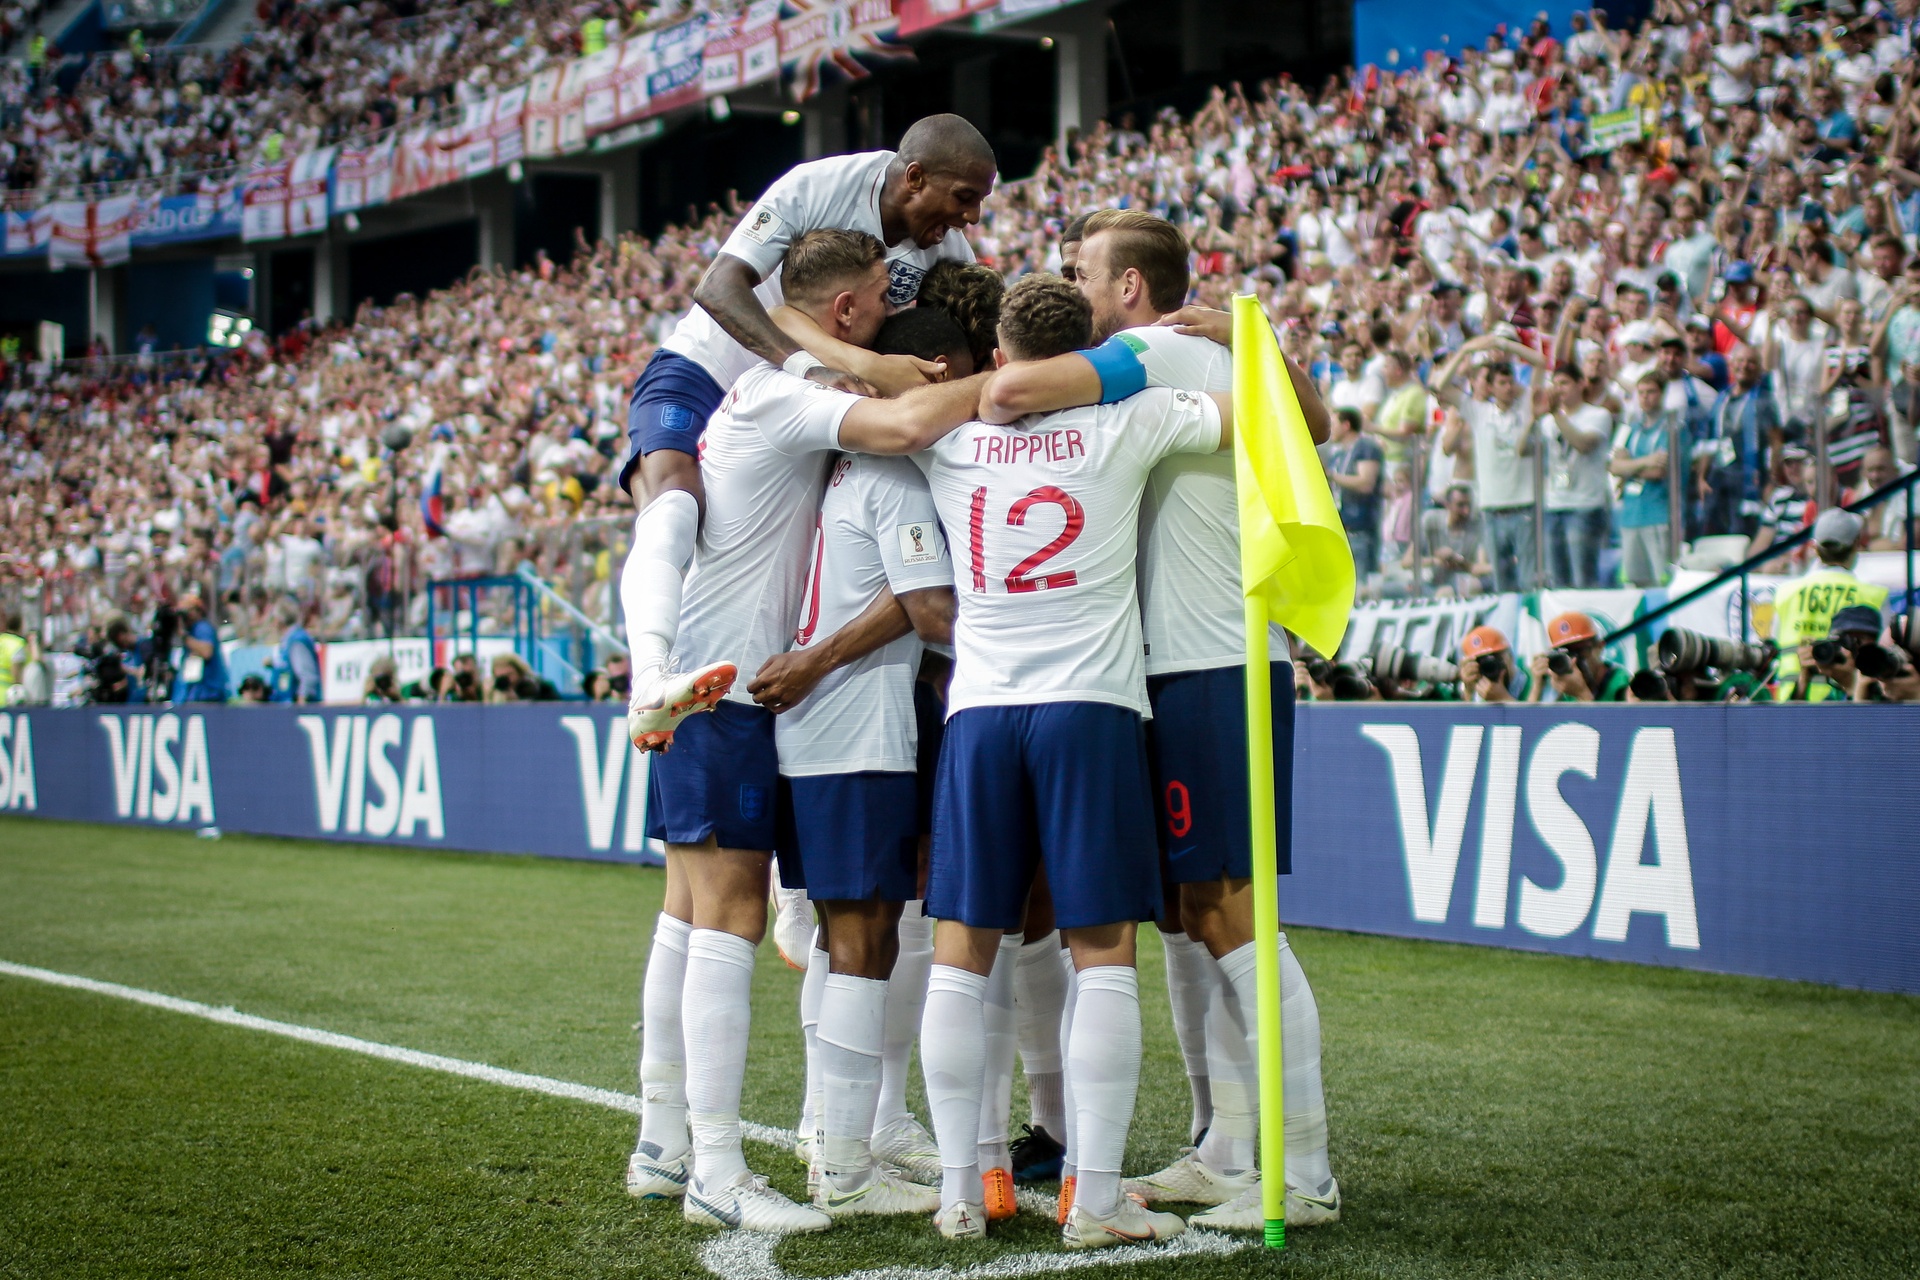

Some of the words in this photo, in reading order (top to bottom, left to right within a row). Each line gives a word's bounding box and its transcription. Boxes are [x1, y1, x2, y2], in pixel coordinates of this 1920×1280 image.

[972, 429, 1086, 464] TRIPPIER
[796, 510, 825, 647] 0
[969, 484, 1086, 594] 12
[1794, 620, 1830, 632] STEW
[1798, 583, 1858, 614] 16375
[0, 713, 37, 810] SA
[100, 713, 215, 823] VISA
[298, 713, 445, 838] VISA
[560, 716, 665, 856] VI
[1165, 779, 1193, 839] 9
[1360, 722, 1700, 949] VISA
